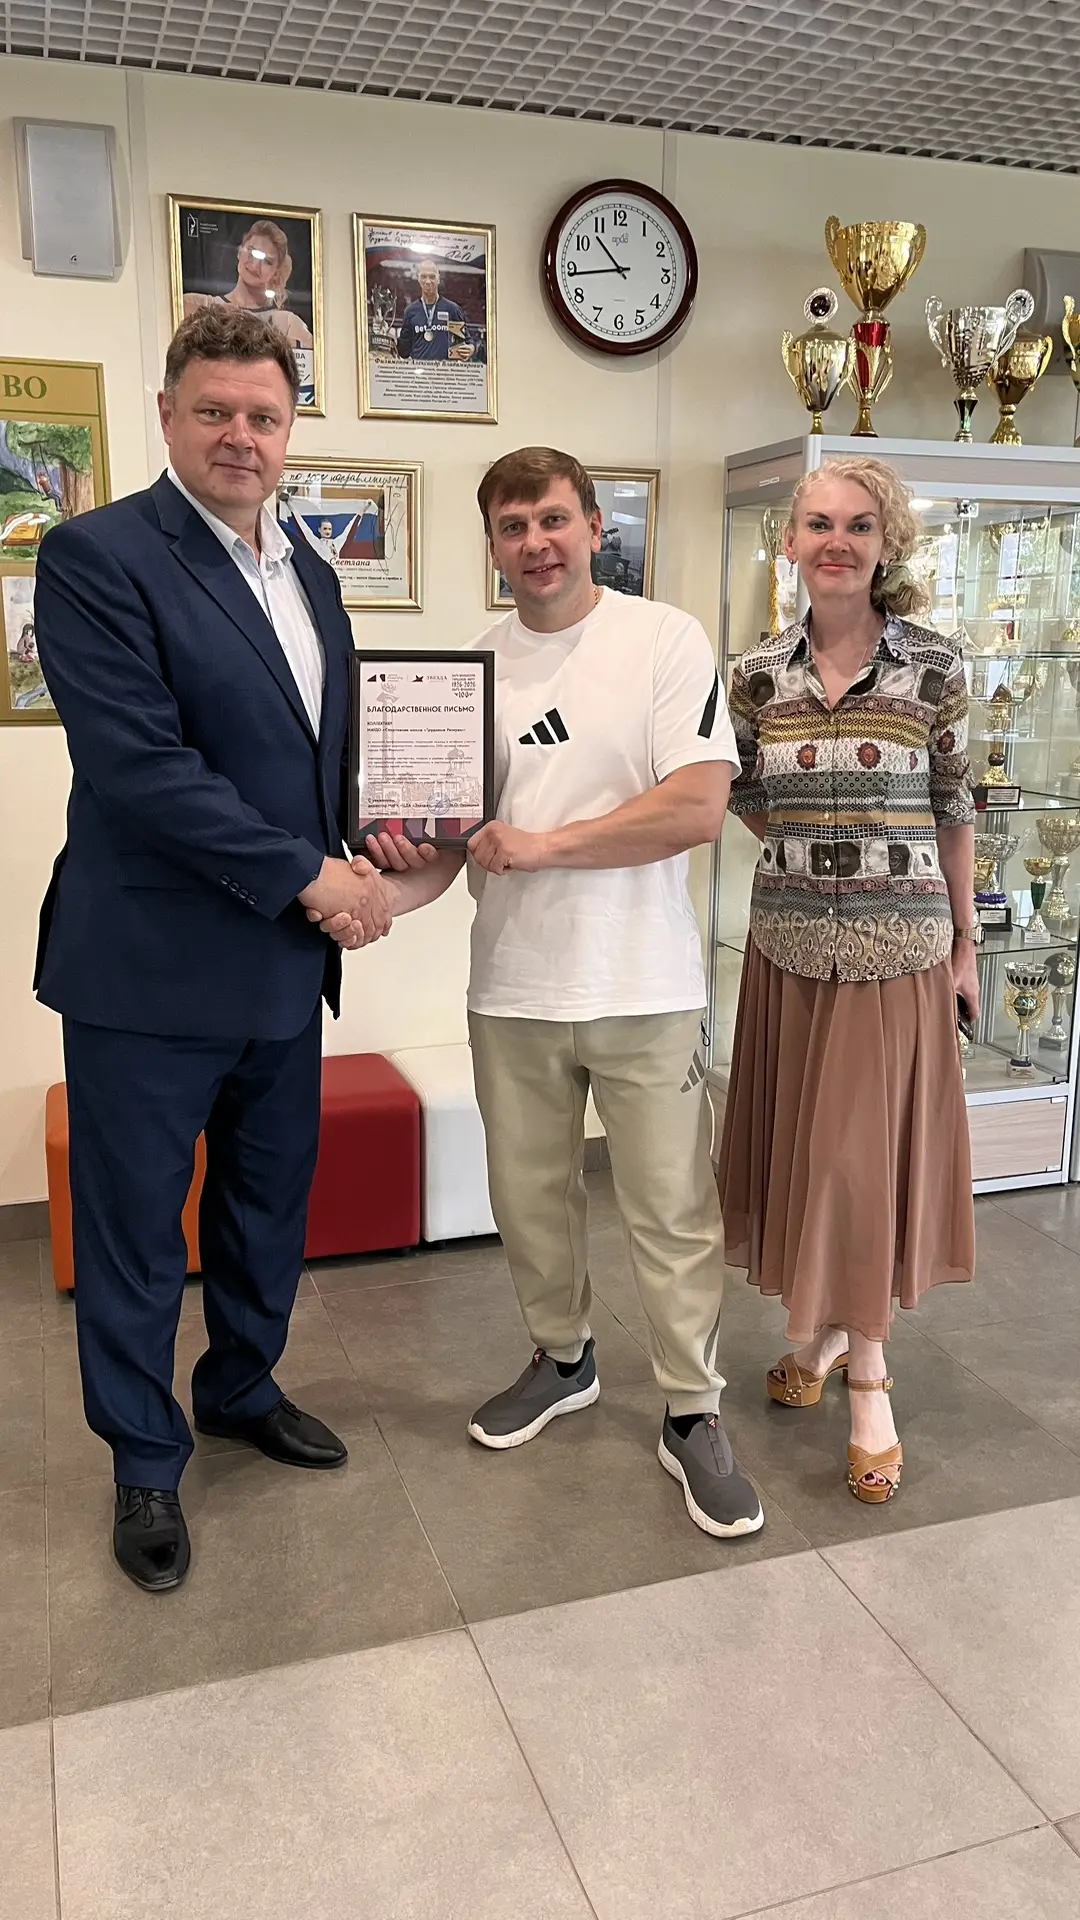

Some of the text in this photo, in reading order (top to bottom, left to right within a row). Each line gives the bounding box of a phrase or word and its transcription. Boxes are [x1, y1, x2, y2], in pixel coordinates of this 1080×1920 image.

[594, 217, 605, 233] 11
[613, 210, 628, 227] 12
[642, 221, 647, 237] 1
[576, 235, 590, 251] 10
[655, 241, 666, 258] 2
[567, 261, 577, 277] 9
[660, 268, 671, 284] 3
[574, 288, 584, 303] 8
[650, 293, 662, 309] 4
[592, 306, 603, 322] 7
[614, 314, 624, 330] 6
[634, 309, 646, 325] 5
[329, 557, 371, 567] Светлана
[366, 705, 475, 713] БЛАГОДАРСТВЕННОЕ ПИСЬМО
